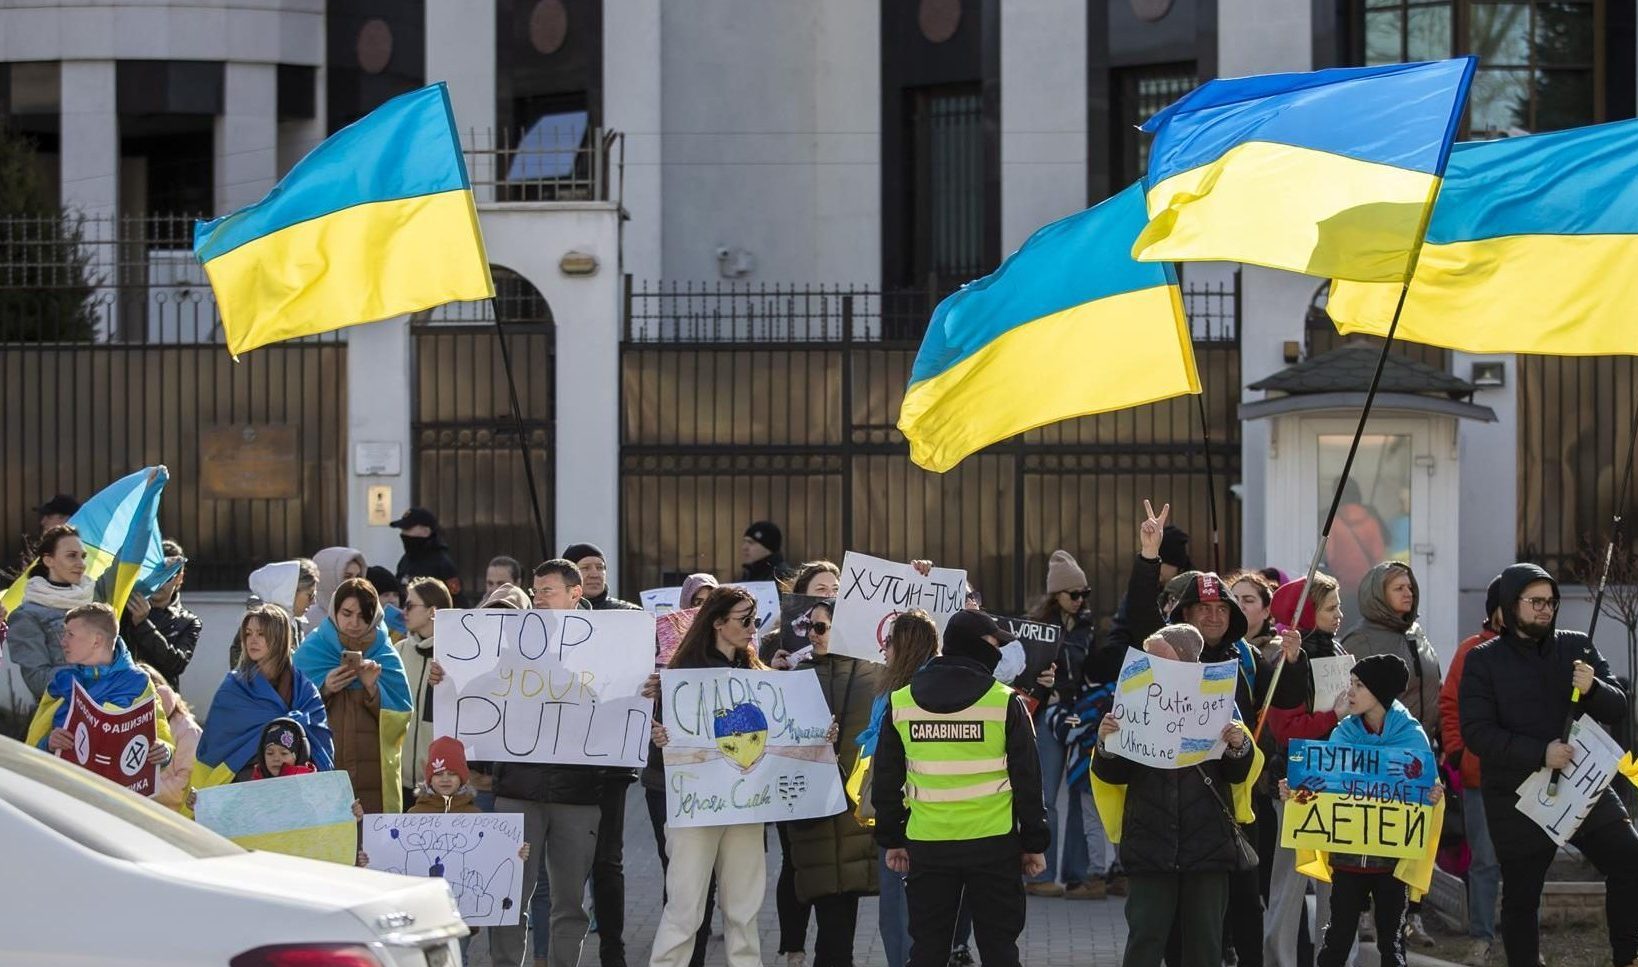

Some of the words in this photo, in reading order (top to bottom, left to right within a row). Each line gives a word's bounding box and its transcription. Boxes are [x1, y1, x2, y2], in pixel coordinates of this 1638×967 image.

[447, 612, 592, 662] STOP
[1008, 620, 1056, 643] WORLD
[102, 710, 154, 734] ФАШИЗМУ
[1198, 693, 1226, 725] get
[911, 723, 982, 740] CARABINIERI
[1166, 716, 1186, 734] of
[1306, 746, 1380, 775] ПУТИН
[1338, 779, 1430, 808] УБИВАЕТ
[1292, 802, 1425, 849] ДЕТЕЙ
